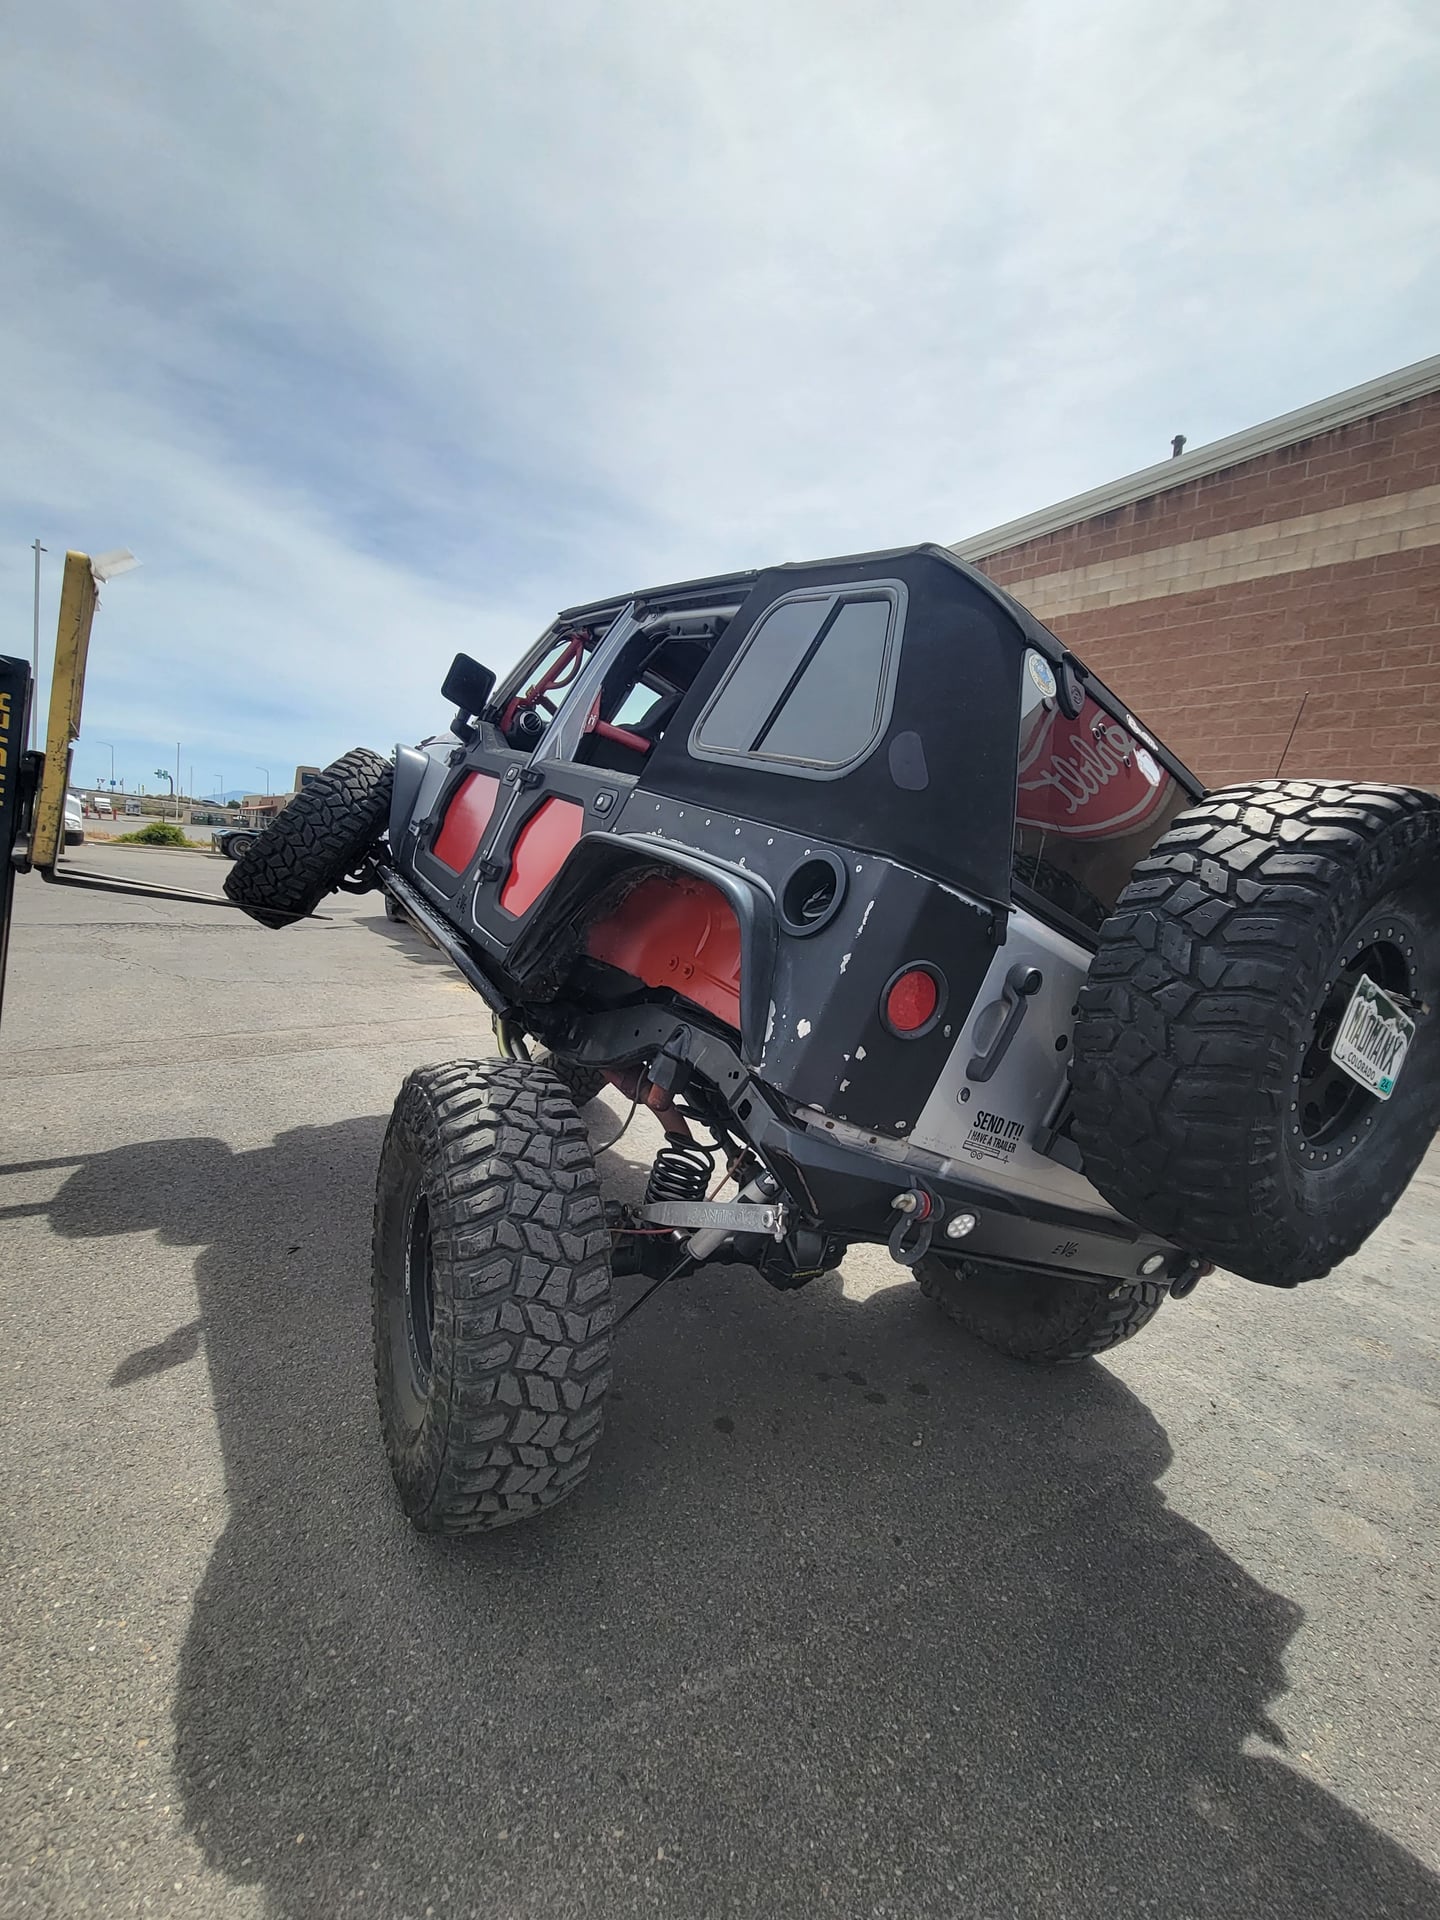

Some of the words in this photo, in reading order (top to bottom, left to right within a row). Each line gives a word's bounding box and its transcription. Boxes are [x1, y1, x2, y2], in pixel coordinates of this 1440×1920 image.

[1344, 1000, 1404, 1076] MADMANX
[1347, 1051, 1376, 1081] COLORADO
[1380, 1078, 1390, 1090] 24
[973, 1110, 1005, 1134] SEND
[1003, 1120, 1025, 1141] IT!!
[970, 1130, 989, 1145] HAVE
[993, 1137, 1017, 1153] TRAILER
